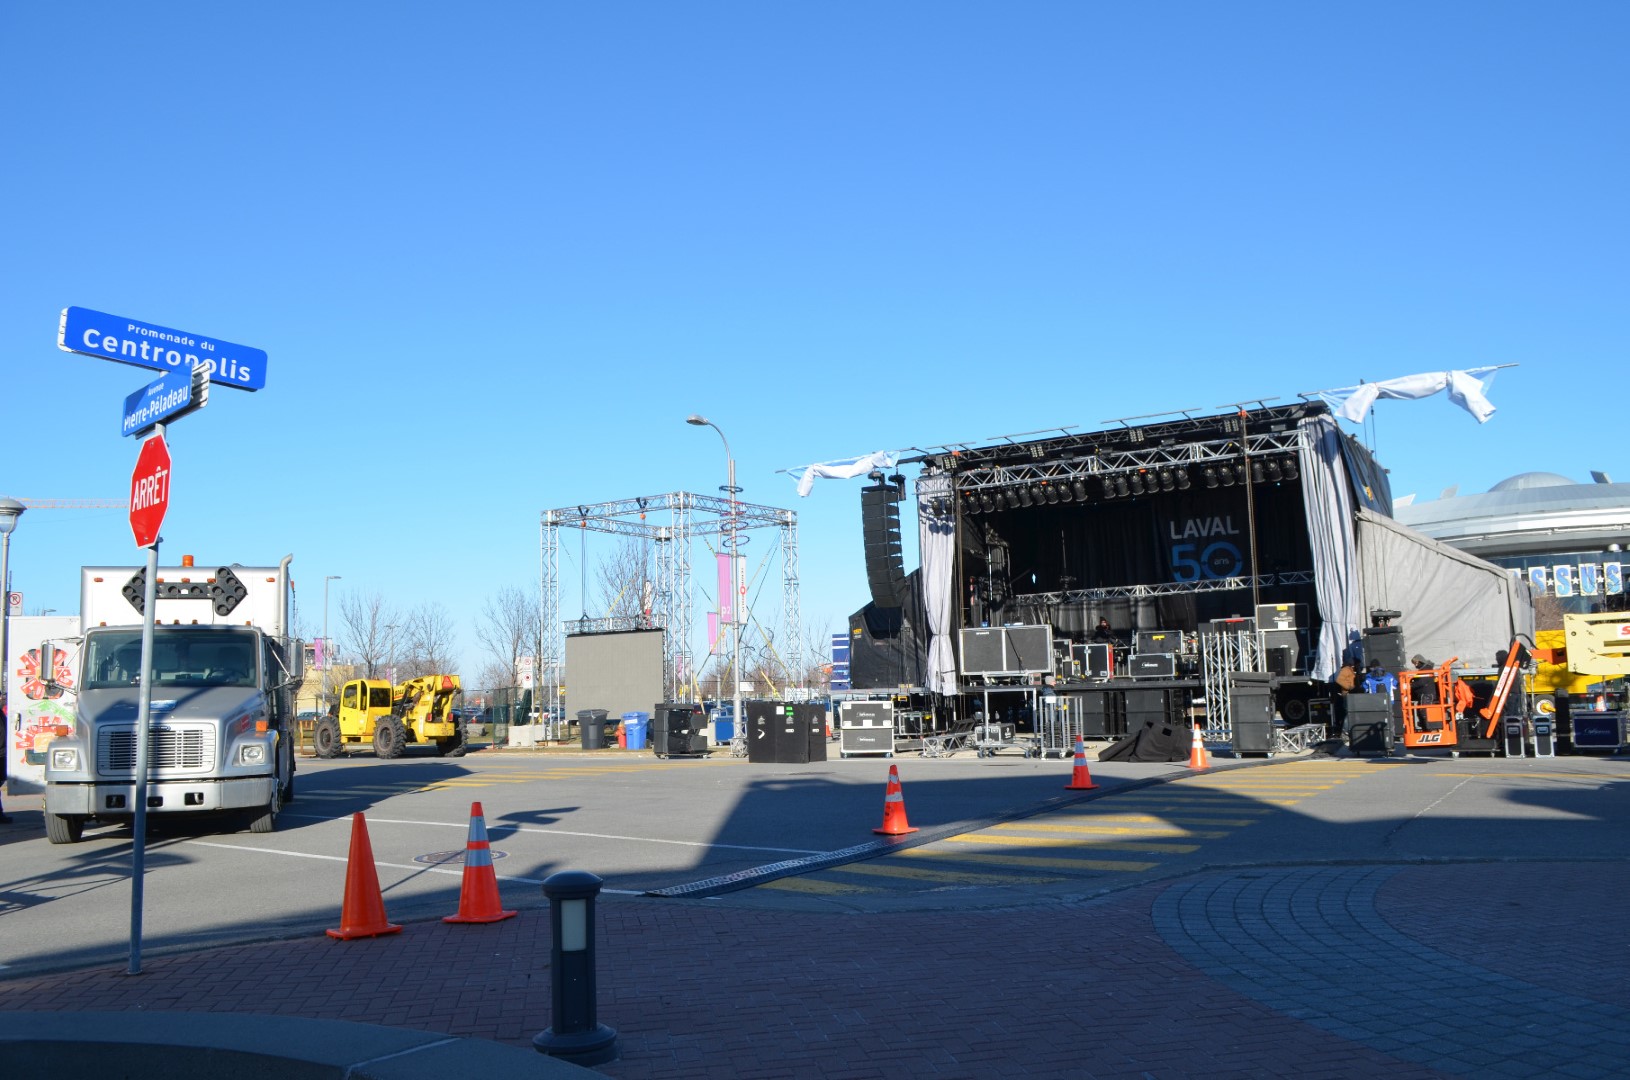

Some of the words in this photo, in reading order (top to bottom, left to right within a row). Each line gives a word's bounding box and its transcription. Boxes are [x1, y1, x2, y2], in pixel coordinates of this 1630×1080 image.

[127, 323, 195, 347] Promenade
[200, 341, 215, 352] du
[123, 385, 189, 432] Pierre-Péladeau
[131, 465, 168, 513] ARRÊT
[1169, 515, 1239, 540] LAVAL
[1171, 541, 1243, 583] 50
[1513, 564, 1621, 596] SSUS
[1417, 733, 1441, 743] JLG
